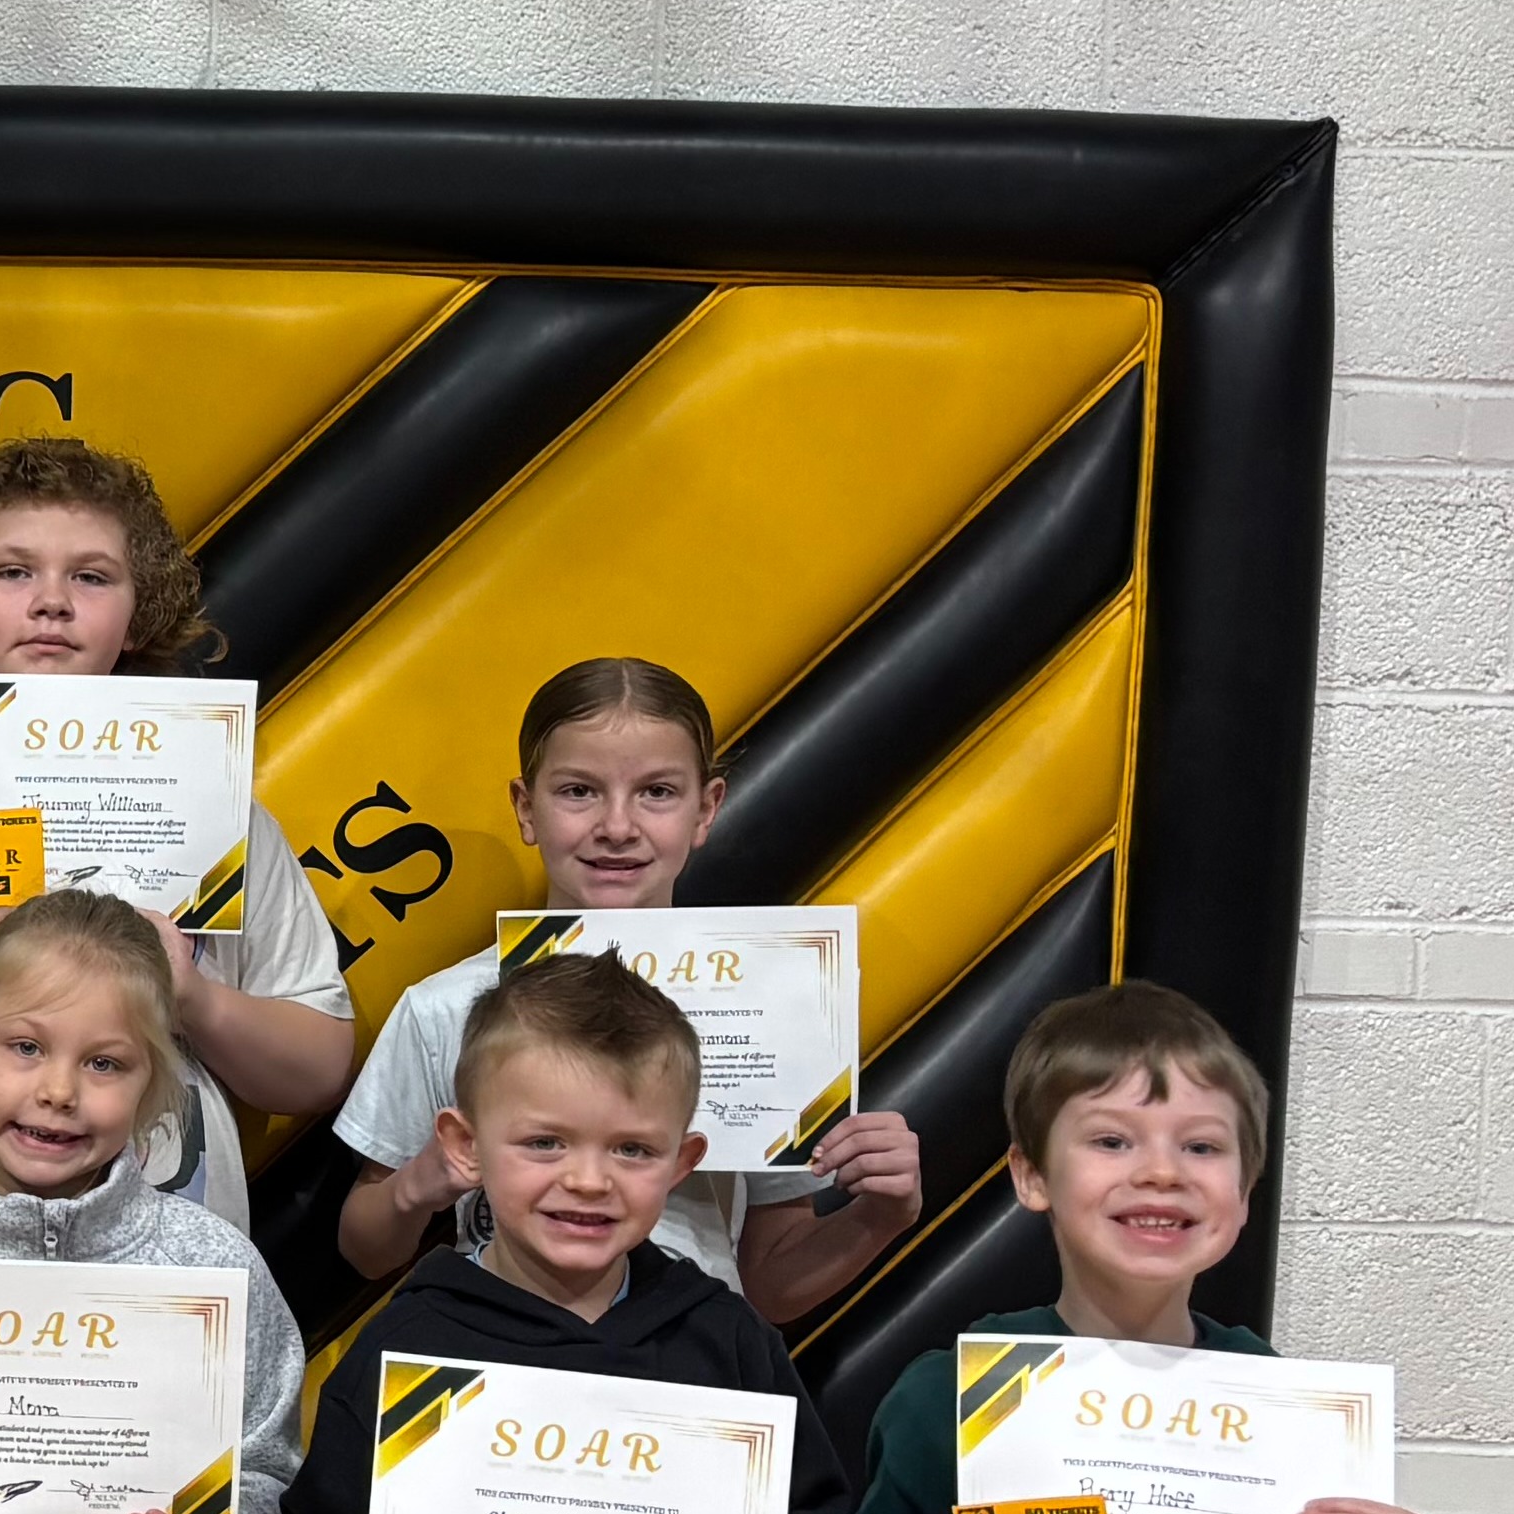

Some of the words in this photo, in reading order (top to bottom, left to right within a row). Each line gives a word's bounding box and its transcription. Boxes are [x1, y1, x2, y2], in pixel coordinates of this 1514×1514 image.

[24, 718, 162, 752] SOAR
[637, 949, 745, 984] OAR
[1075, 1388, 1253, 1444] SOAR
[490, 1418, 663, 1474] SOAR
[1148, 1483, 1196, 1510] Huff
